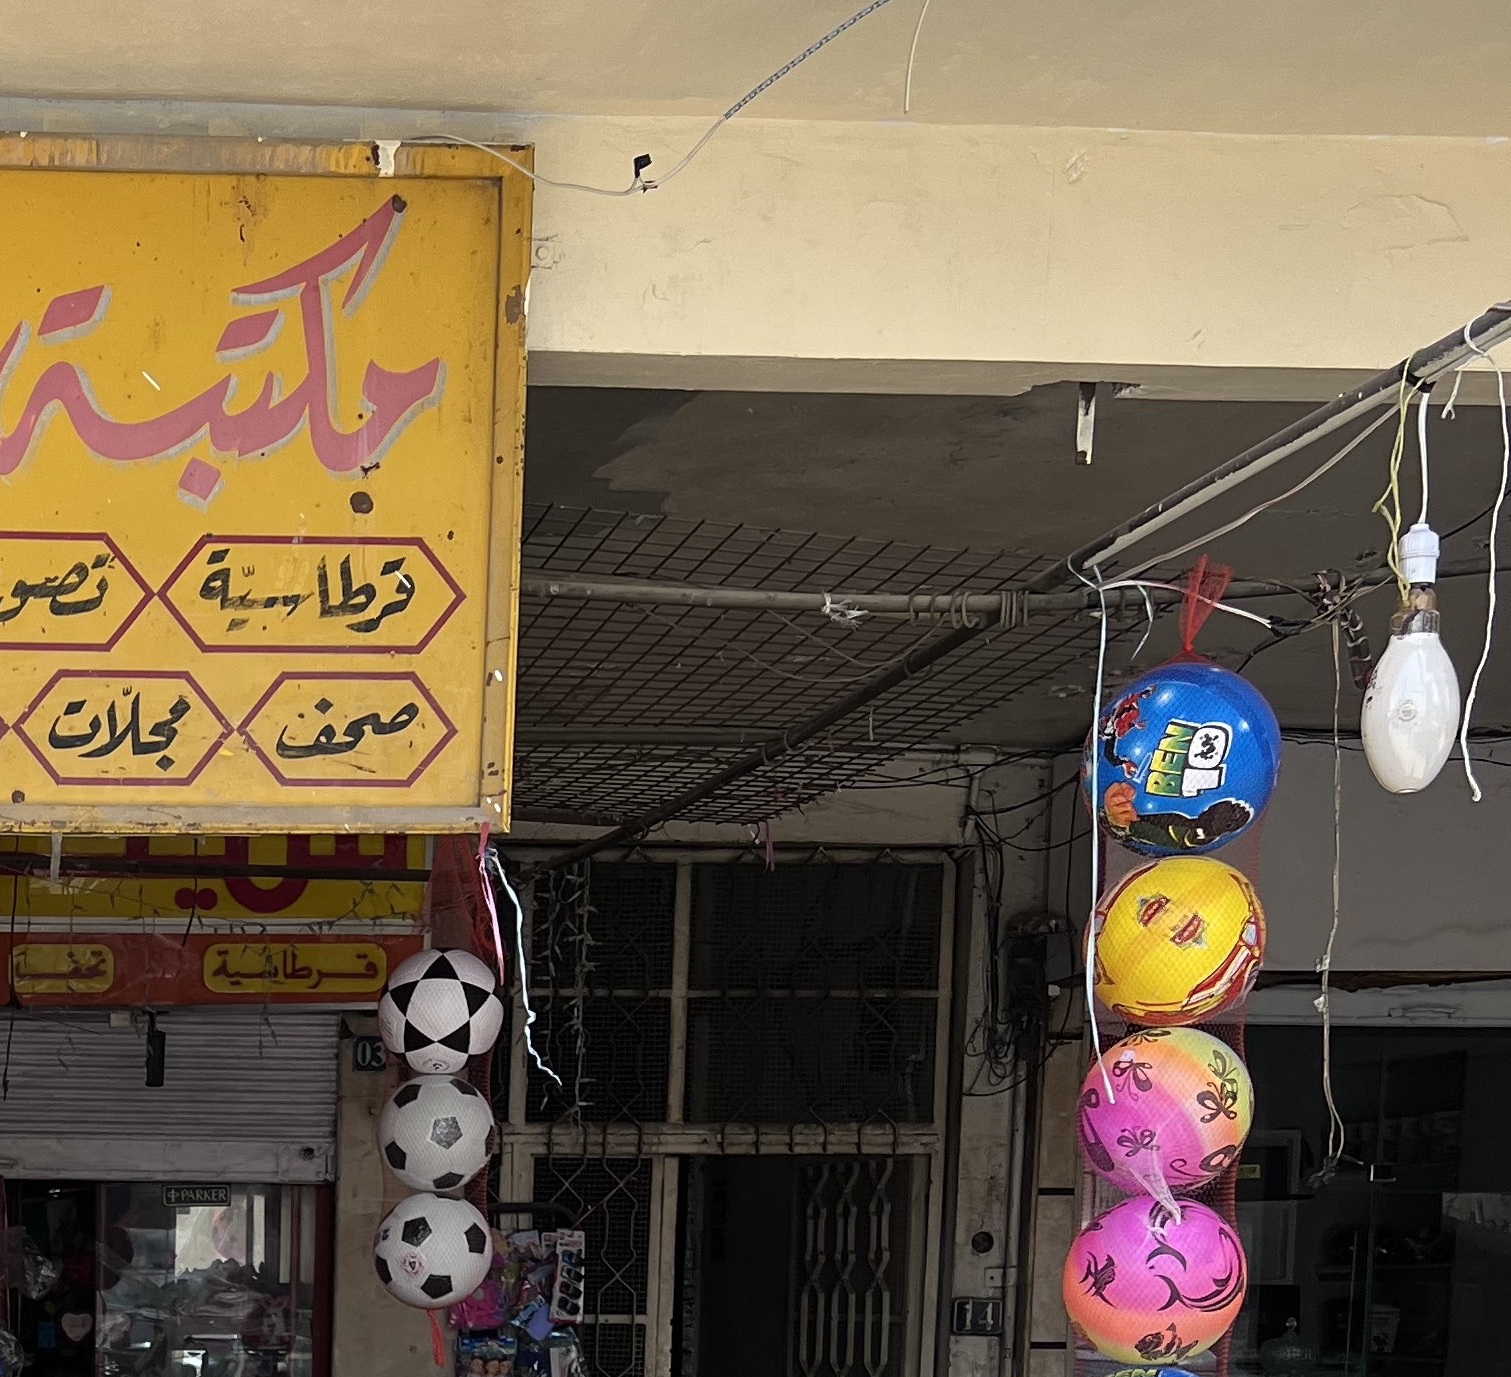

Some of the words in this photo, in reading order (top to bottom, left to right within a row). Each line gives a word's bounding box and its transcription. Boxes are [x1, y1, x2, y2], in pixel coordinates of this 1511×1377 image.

[274, 699, 420, 760] صحف
[1145, 719, 1197, 798] BEN
[356, 1041, 387, 1067] 03
[180, 1188, 227, 1202] PARKER
[962, 1301, 996, 1328] 14
